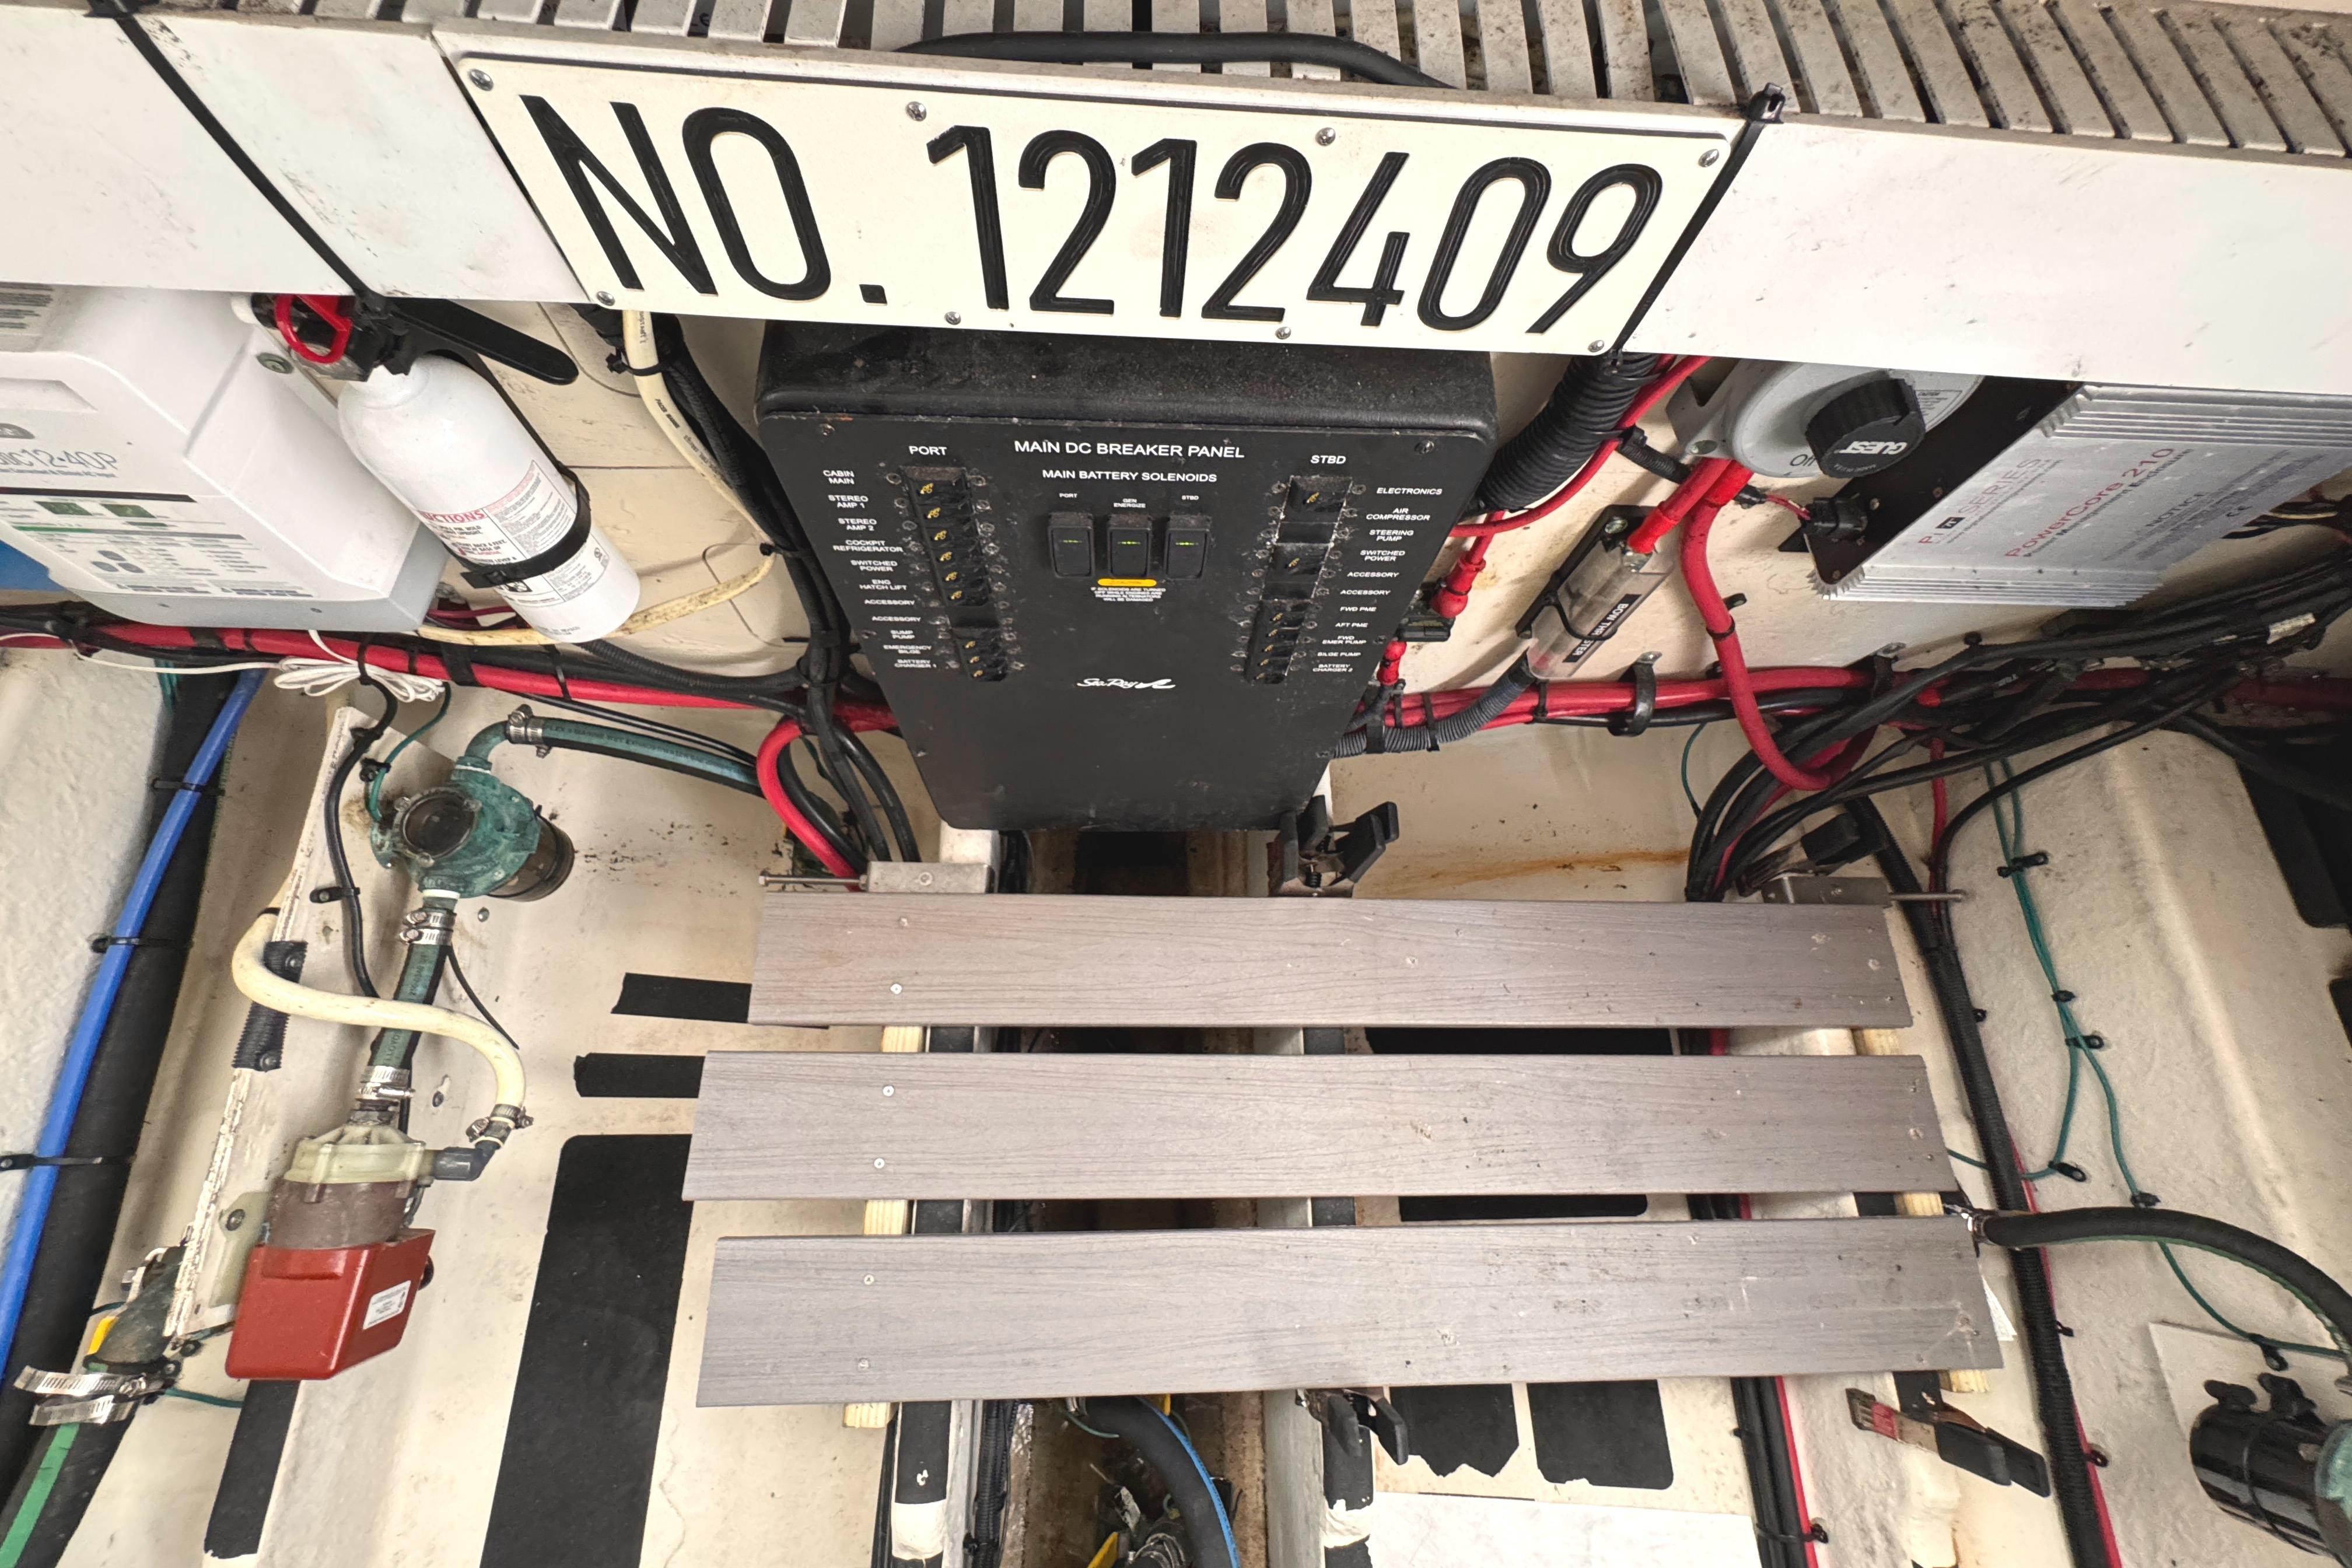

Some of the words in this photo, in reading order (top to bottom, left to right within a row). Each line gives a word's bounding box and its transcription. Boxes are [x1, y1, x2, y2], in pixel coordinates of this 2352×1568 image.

[520, 94, 887, 305] NO.
[926, 124, 1662, 334] 1212409
[909, 446, 947, 455] PORT
[1014, 441, 1060, 453] MAIN
[1066, 442, 1092, 454] DC
[1097, 443, 1182, 457] BREAKER
[1188, 446, 1245, 458] PANEL
[1839, 440, 1908, 454] GUEST
[1310, 455, 1346, 464] STBD
[1042, 470, 1076, 479] MAIN
[1079, 471, 1138, 481] BATTERY
[1141, 473, 1217, 482] SOLENOIDS
[1958, 459, 2042, 513] SERIES
[2006, 482, 2124, 556] PowerCore
[2122, 448, 2174, 477] 210
[1606, 603, 1629, 621] BOW
[1572, 621, 1612, 656] THRSTER
